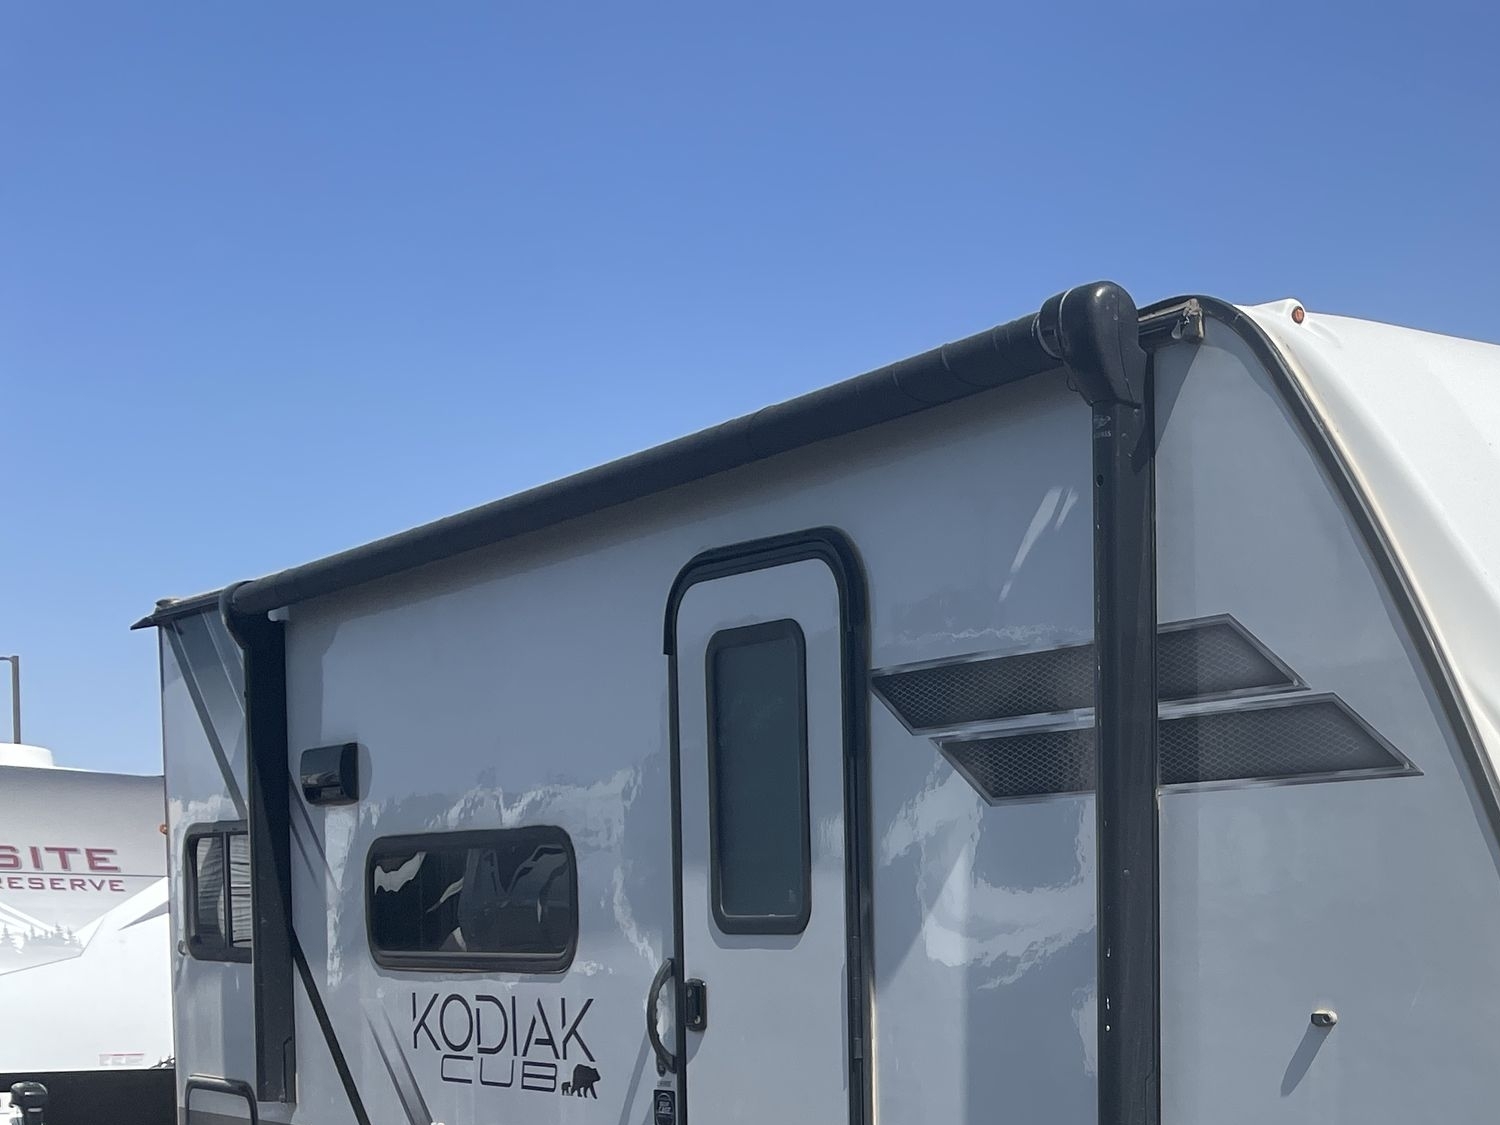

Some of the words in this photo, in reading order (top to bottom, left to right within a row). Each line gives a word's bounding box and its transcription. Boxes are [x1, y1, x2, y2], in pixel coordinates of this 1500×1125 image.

[0, 845, 121, 872] SITE
[0, 876, 126, 892] ESERVE
[412, 992, 596, 1062] KODIAK
[441, 1054, 558, 1093] CUB
